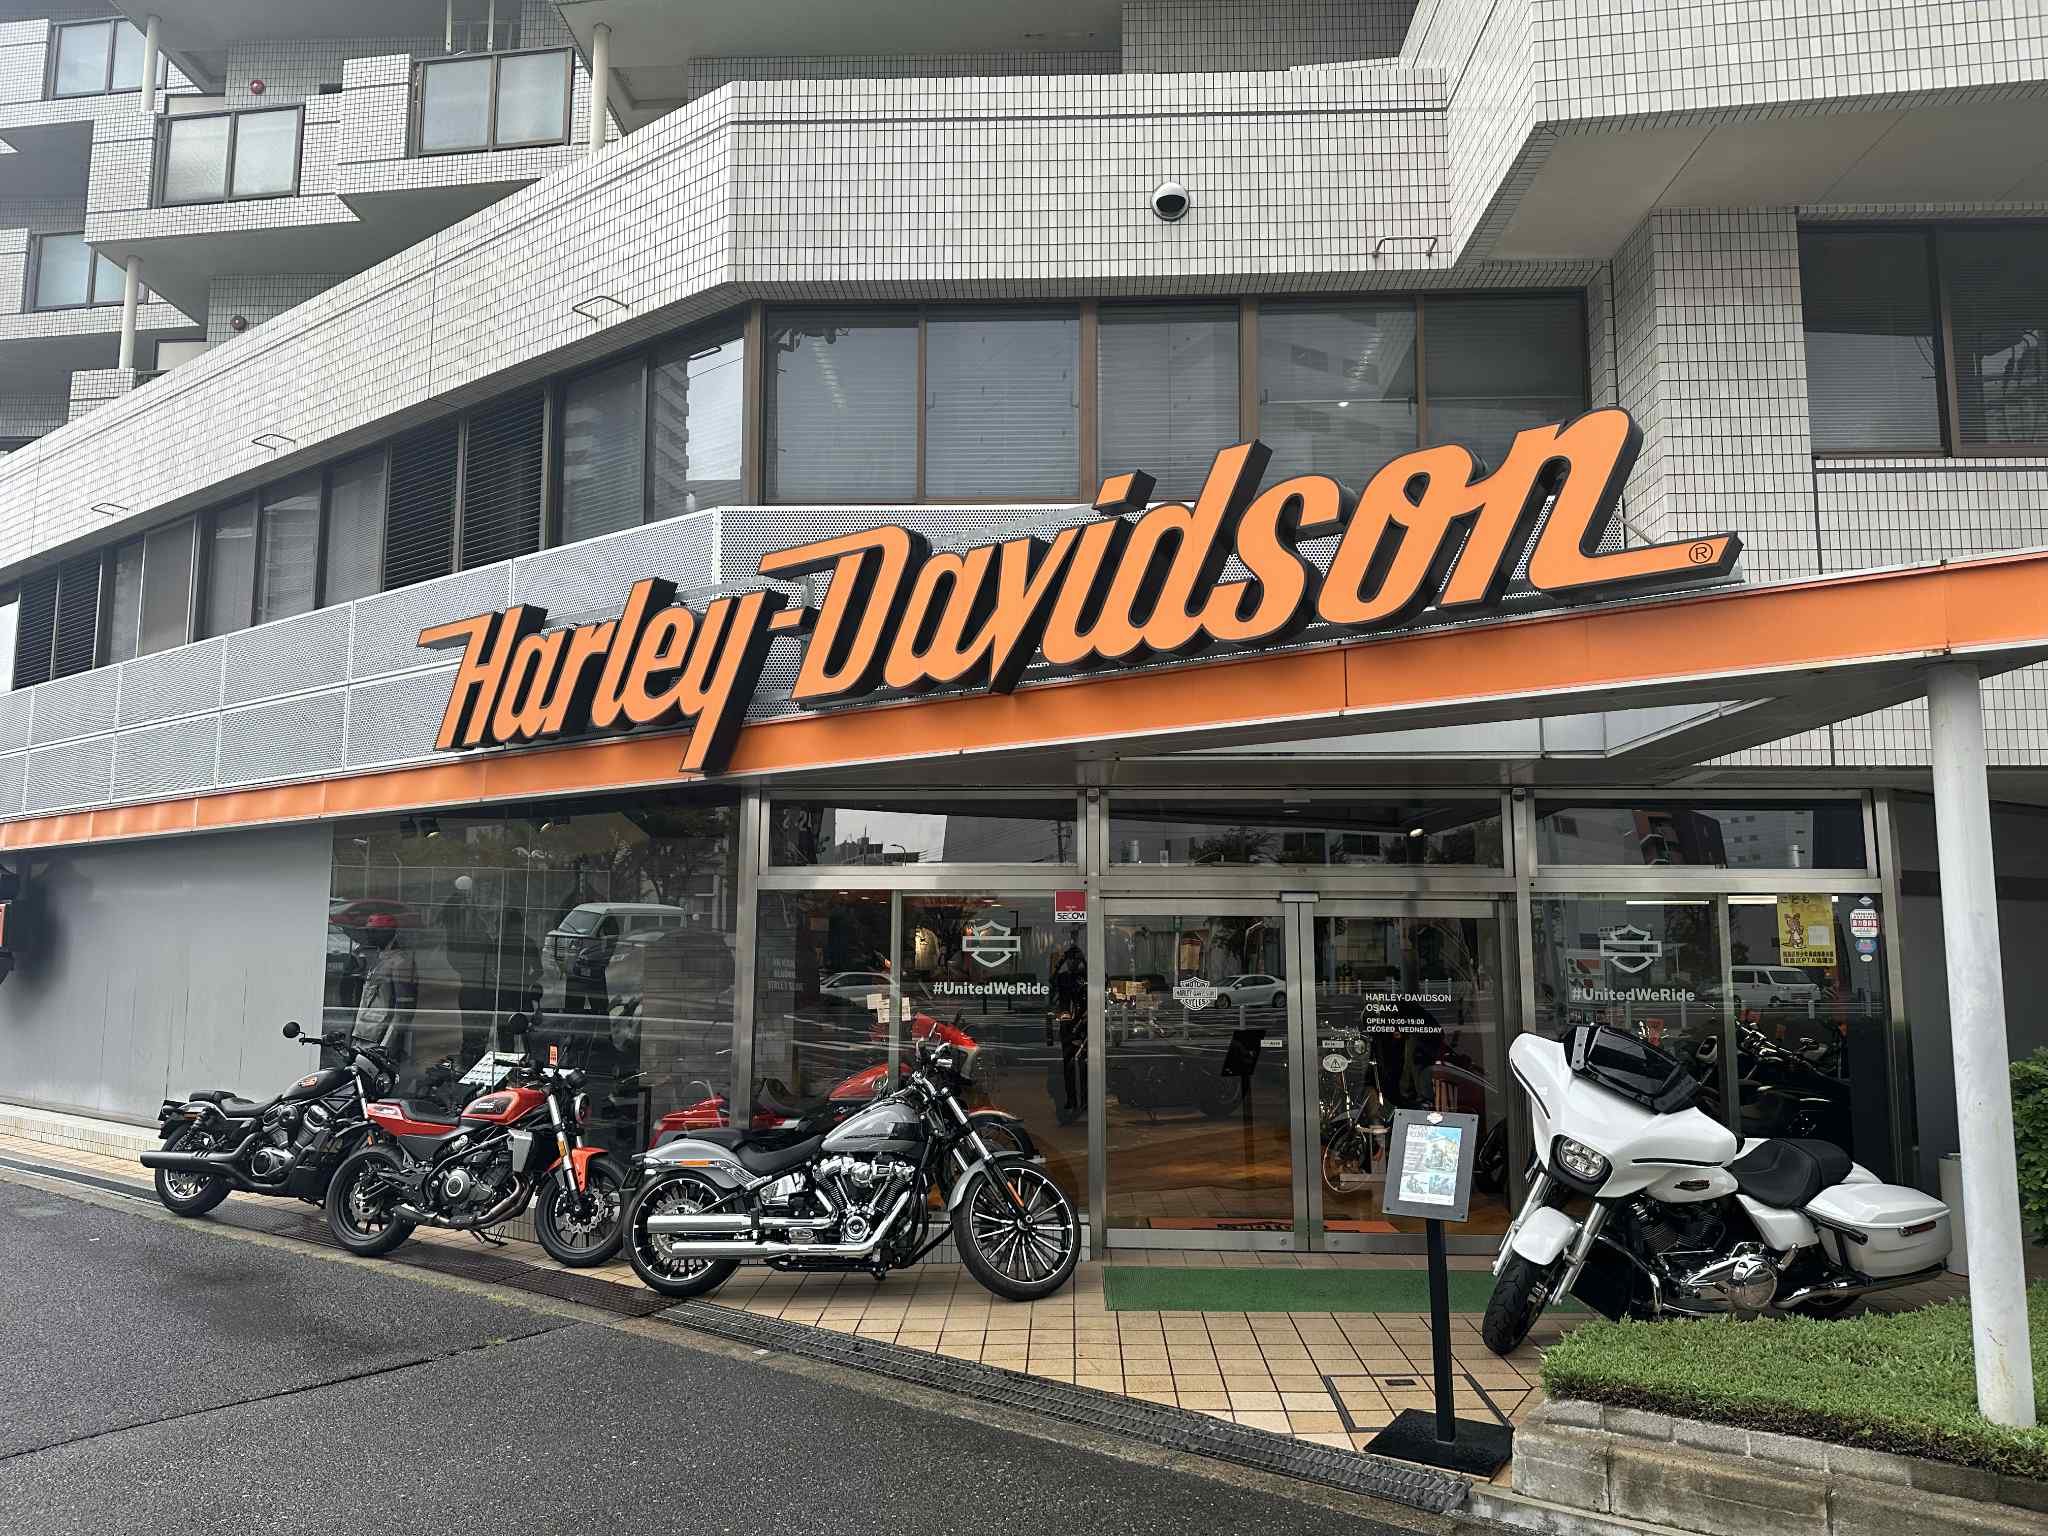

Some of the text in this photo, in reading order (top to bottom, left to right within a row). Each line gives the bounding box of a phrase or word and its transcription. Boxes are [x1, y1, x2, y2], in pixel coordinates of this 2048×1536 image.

[418, 406, 1740, 773] Harley-Davidson
[1057, 912, 1085, 920] SECOM
[933, 981, 1050, 996] #UnitedWeRide
[1571, 987, 1696, 1002] #UnitedWeRide
[1365, 993, 1452, 1002] HARLEY-DAVIDSON
[1366, 1004, 1399, 1012] OSAKA
